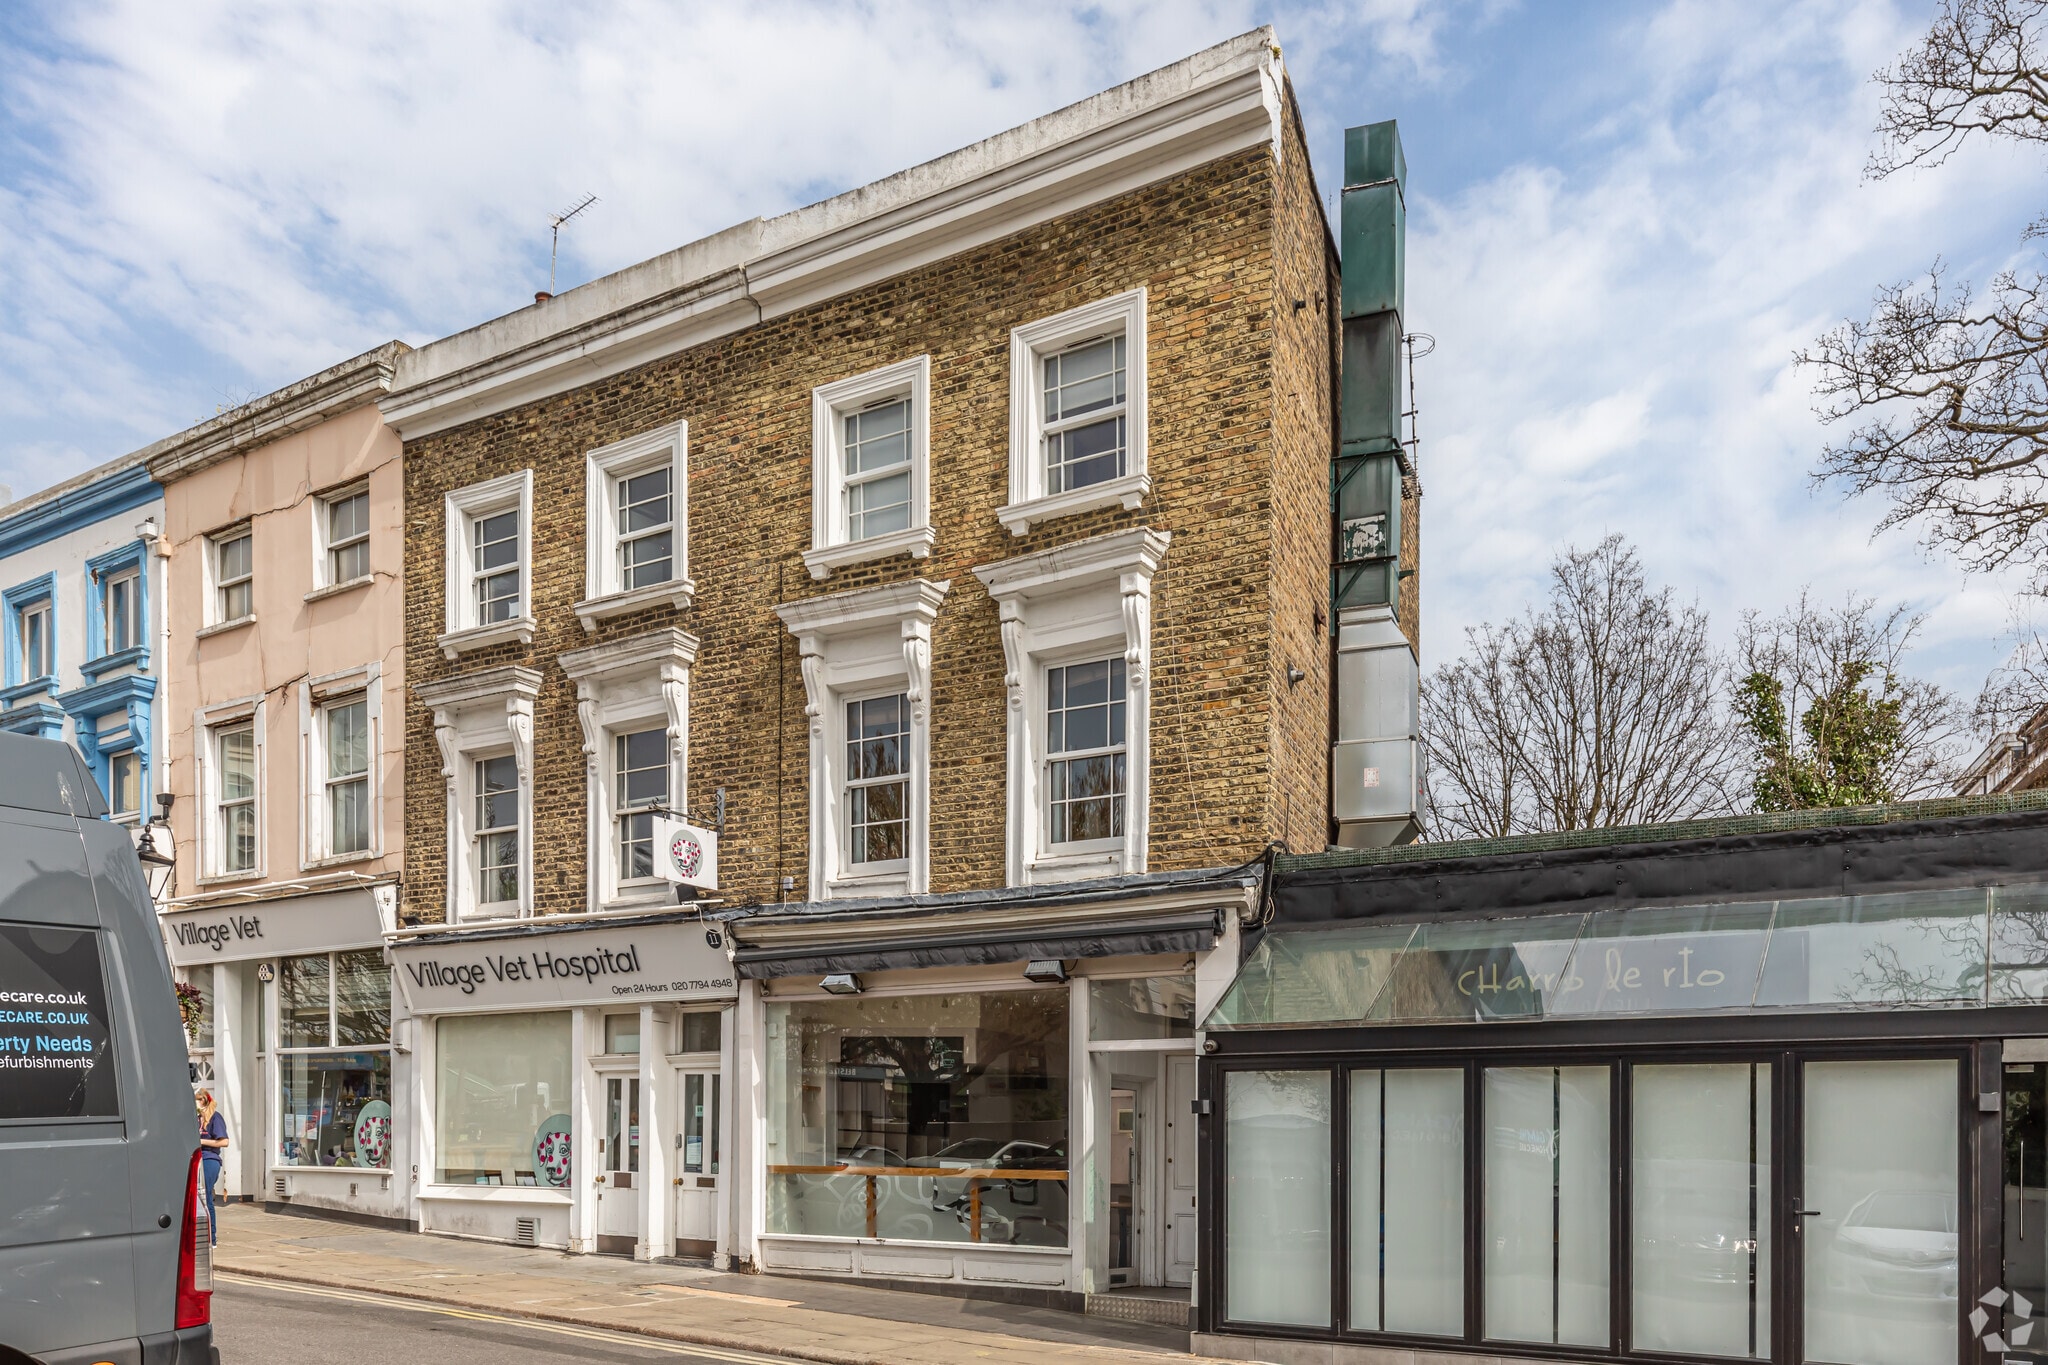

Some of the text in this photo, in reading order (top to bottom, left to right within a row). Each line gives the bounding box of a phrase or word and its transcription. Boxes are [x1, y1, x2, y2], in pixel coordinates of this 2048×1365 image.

[172, 915, 263, 951] Village Vet
[406, 944, 641, 994] Village Vet Hospital
[611, 978, 733, 996] Open 24 Hours 020 7794 4948
[0, 992, 88, 1005] ecare.co.uk
[0, 1010, 89, 1025] ECARE.CO.UK
[36, 1035, 92, 1051] Needs
